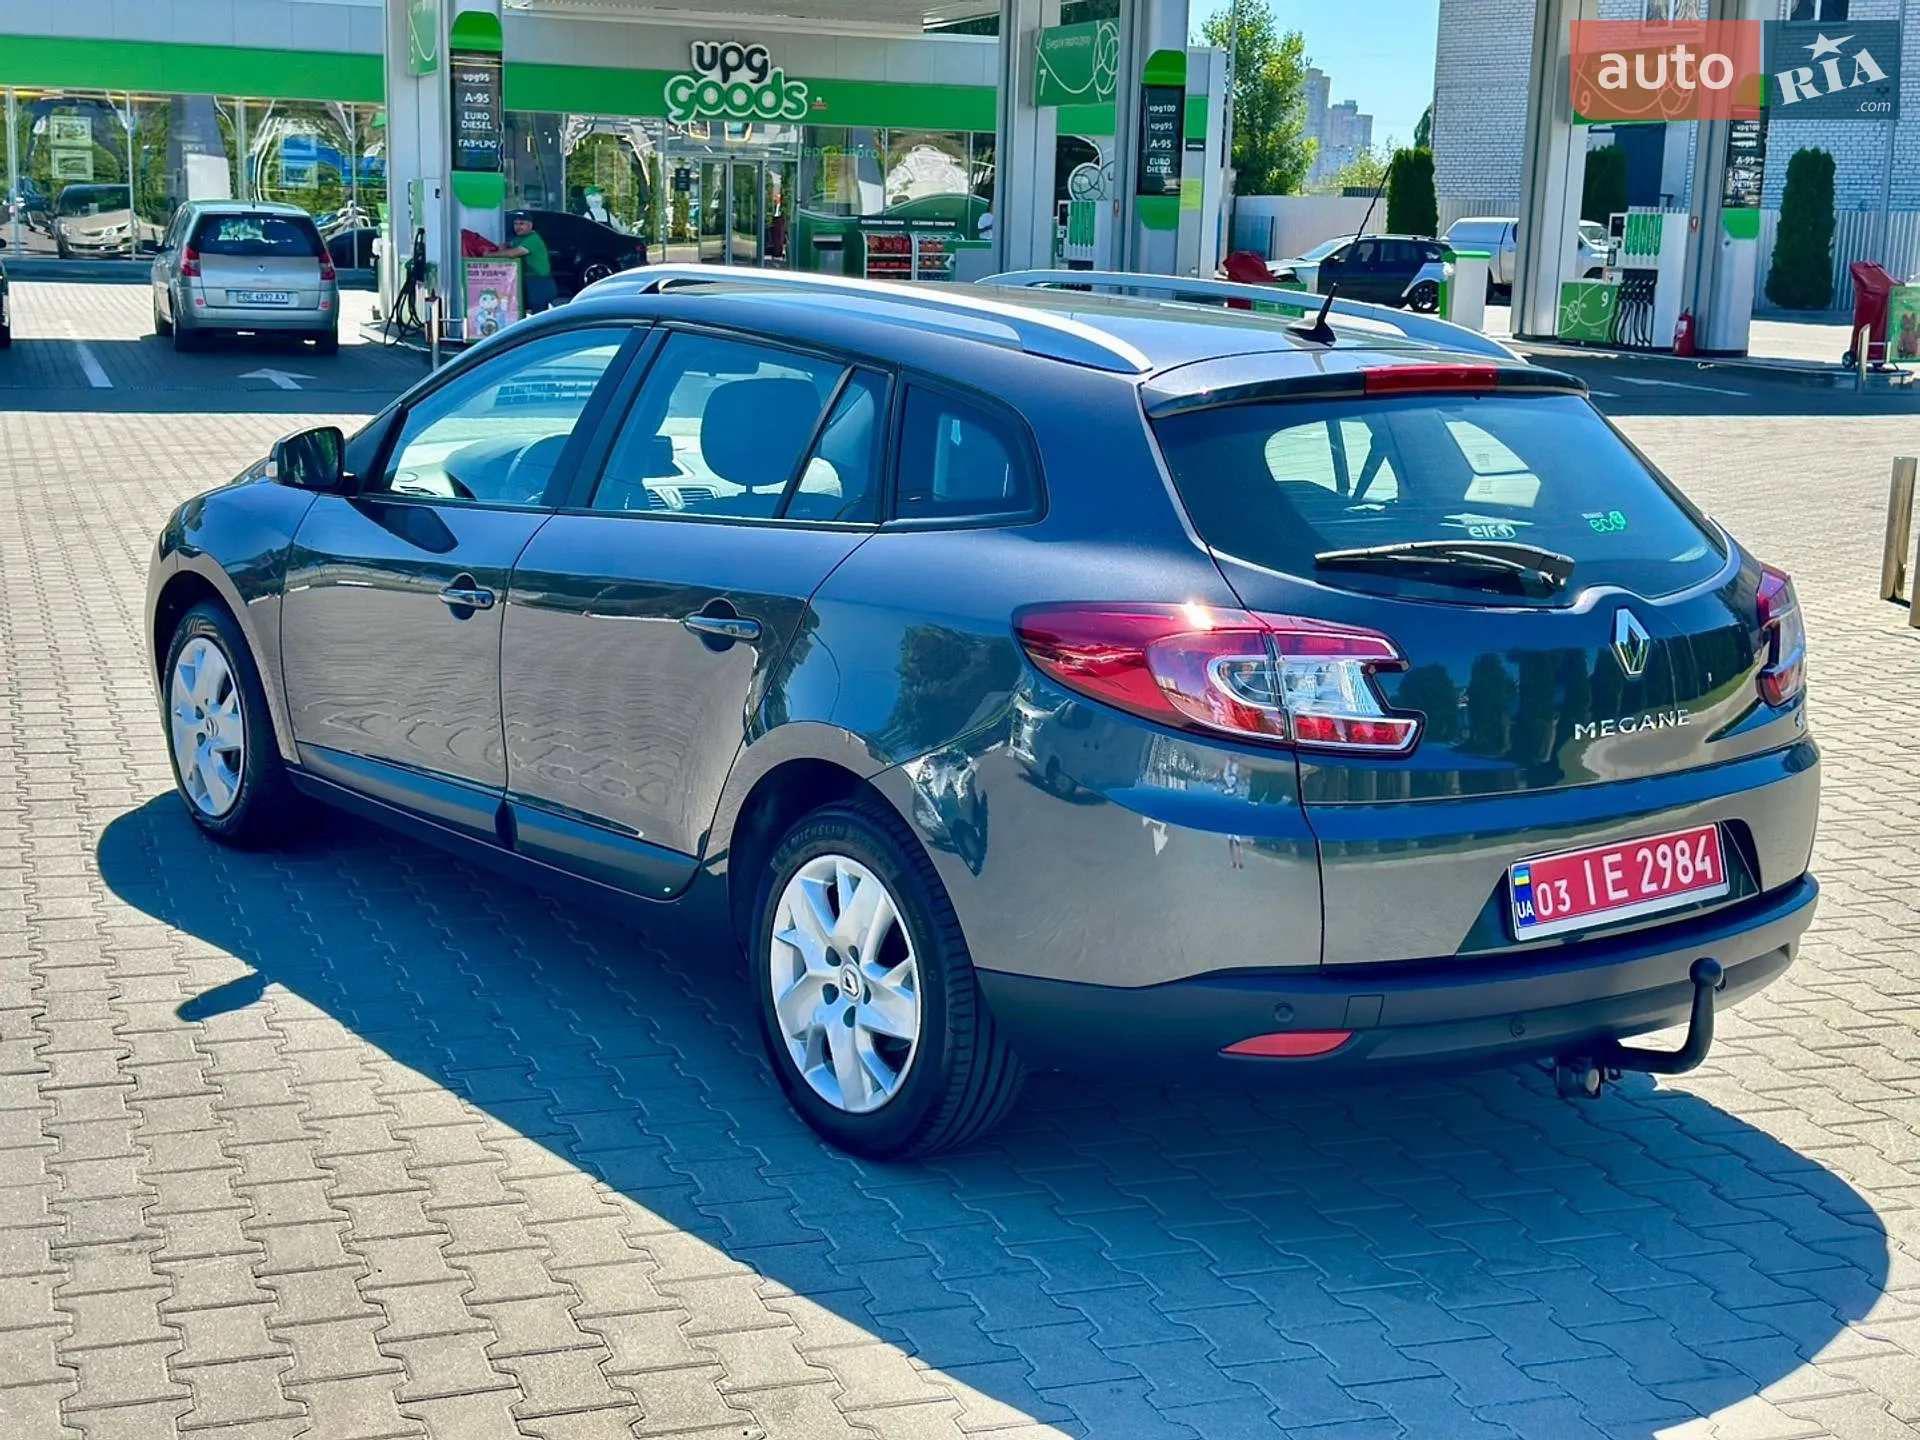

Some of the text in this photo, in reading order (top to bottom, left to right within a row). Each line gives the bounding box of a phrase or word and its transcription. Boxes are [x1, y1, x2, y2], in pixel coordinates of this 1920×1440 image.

[693, 43, 770, 84] upg
[464, 92, 490, 103] A-95
[667, 69, 807, 123] goods
[1149, 104, 1176, 113] upg100
[464, 111, 490, 120] EURO
[461, 120, 492, 129] DIESEL
[1150, 139, 1172, 148] A-95
[1149, 157, 1171, 166] EURO
[1146, 165, 1173, 174] DIESEL
[1601, 291, 1609, 308] 9
[1574, 709, 1691, 740] MEGANE
[1536, 834, 1713, 916] 03 IE 2984
[1517, 901, 1536, 918] UA
